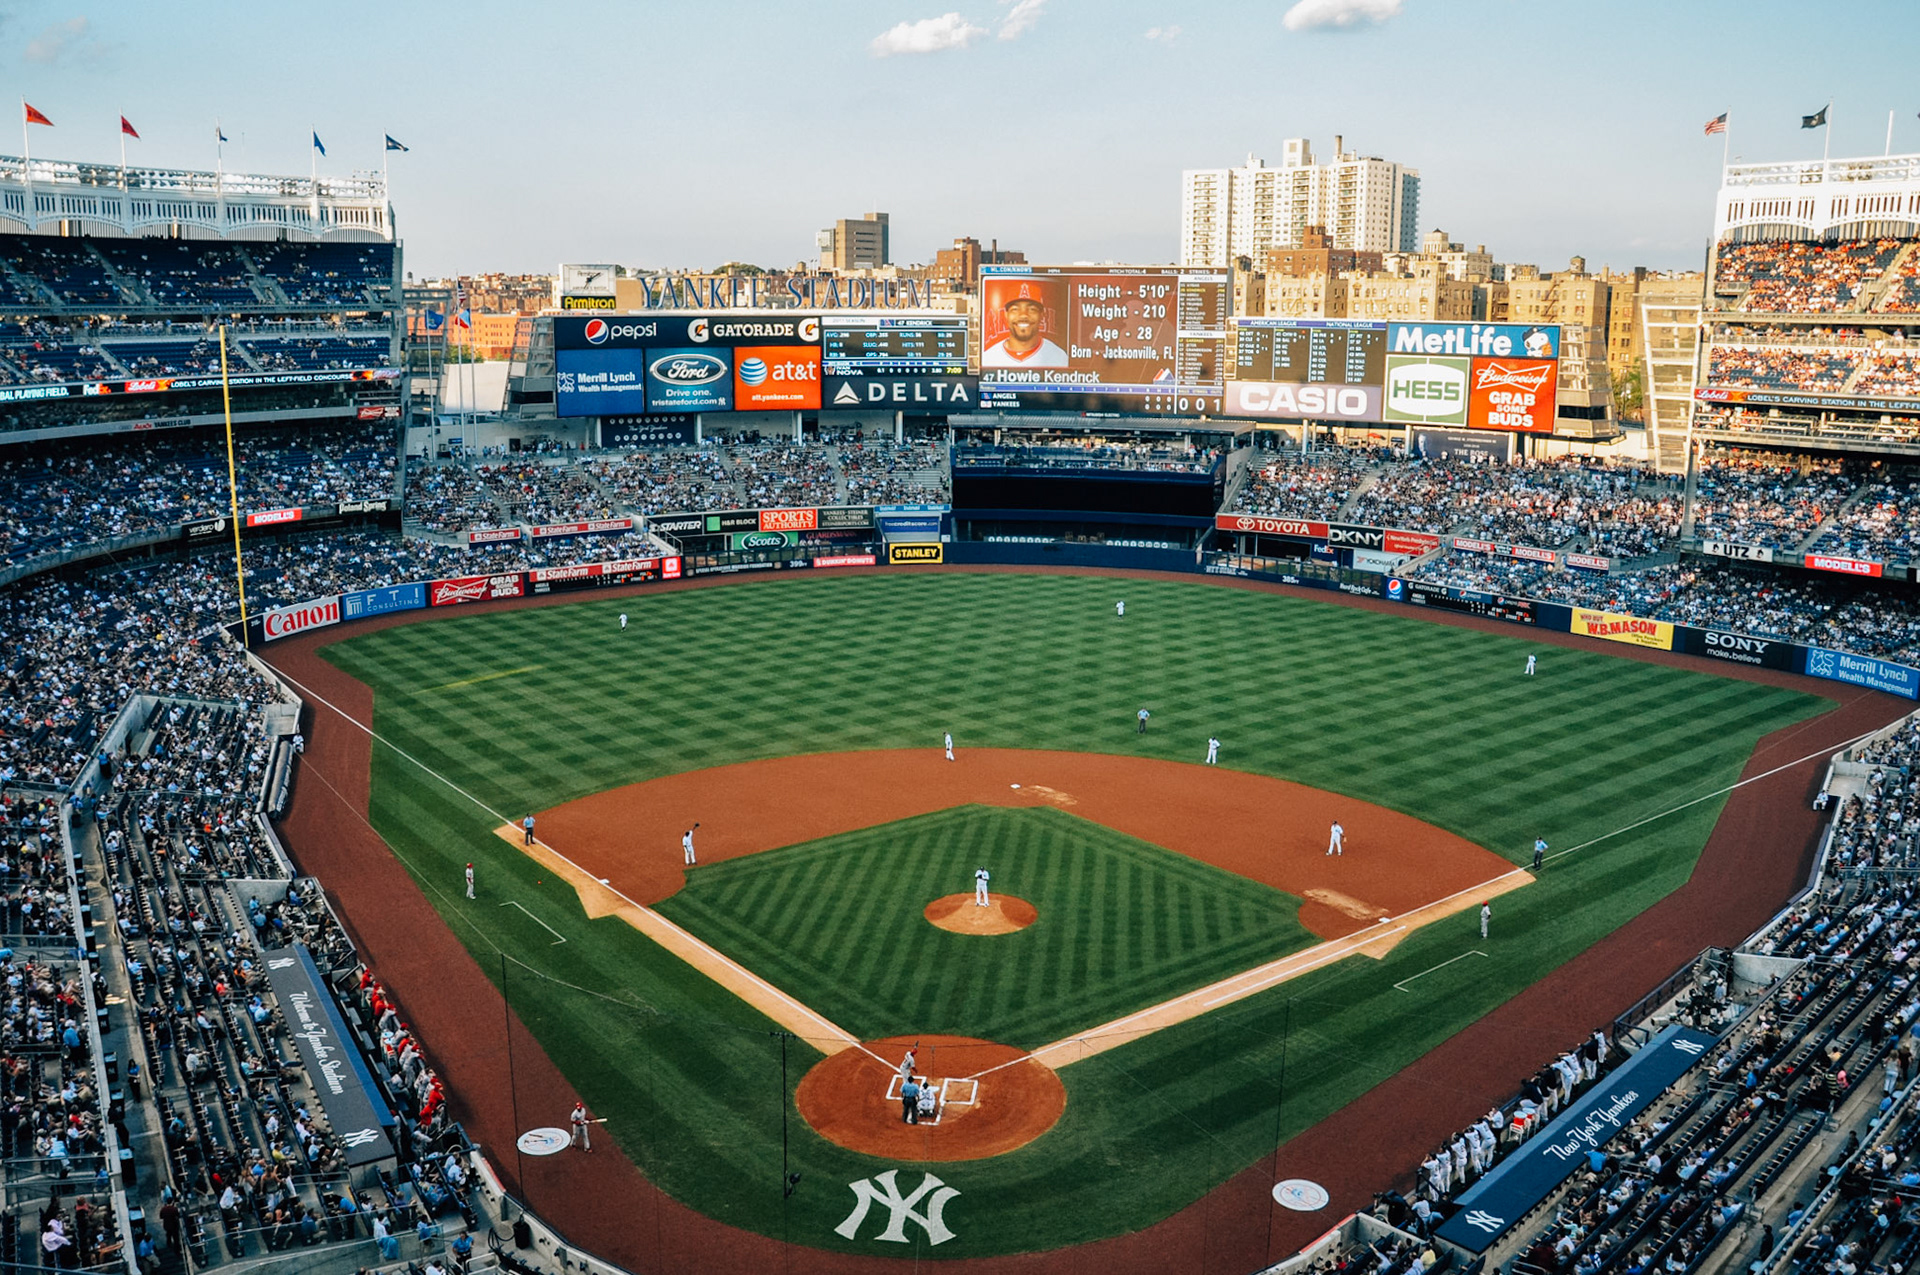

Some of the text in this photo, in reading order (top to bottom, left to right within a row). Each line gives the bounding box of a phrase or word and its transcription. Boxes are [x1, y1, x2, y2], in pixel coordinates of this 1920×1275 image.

[786, 277, 932, 308] STADIUM
[1078, 284, 1121, 301] Height
[564, 296, 615, 309] Armitron
[1082, 303, 1166, 320] Weight 210
[611, 322, 657, 340] pepsi
[713, 323, 794, 337] GATORADE
[1094, 325, 1152, 342] Age 28
[1394, 324, 1512, 356] MetLife
[1071, 344, 1092, 358] Born
[1163, 346, 1174, 359] FL
[668, 359, 709, 378] Ford
[772, 360, 817, 381] at&t
[983, 369, 1100, 383] 47 Howie Kendrick
[1476, 366, 1548, 384] Budweiser
[170, 380, 197, 388] LOBEL'S
[228, 377, 254, 385] STATION
[313, 373, 353, 381] CONCOURSE
[577, 372, 636, 384] Merrill Lynch
[14, 388, 45, 400] PLAYING
[578, 383, 642, 392] Wealth Management
[666, 389, 690, 397] Drive
[868, 382, 969, 402] DELTA
[1393, 379, 1460, 401] HESS
[652, 398, 718, 407] tristateford.com
[1179, 397, 1220, 412] 0 0 1
[1240, 385, 1367, 415] CASIO
[1488, 391, 1536, 406] GRAB
[1696, 390, 1728, 400] Lobel's
[1747, 394, 1780, 402] LOBEL'S
[1782, 396, 1818, 405] CARVING
[1821, 398, 1855, 407] STATION
[1868, 400, 1886, 408] THE
[1496, 405, 1527, 414] SOME
[154, 420, 177, 428] YANKEES
[178, 419, 191, 427] CLUB
[1488, 412, 1533, 427] BUDS
[762, 510, 814, 523] SPORTS
[660, 521, 702, 532] STARTER
[1257, 519, 1310, 535] TOYOTA
[748, 536, 781, 547] Scotts
[1330, 528, 1383, 546] DKNY
[895, 549, 938, 558] STANLEY
[1313, 544, 1334, 554] FedEx
[1457, 540, 1491, 551] MODELL'S
[1515, 548, 1552, 560] MODELL'S
[1723, 544, 1750, 558] UTZ
[1568, 555, 1608, 569] MODELL'S
[1814, 557, 1870, 574] MODELL'S
[490, 575, 520, 585] GRAB
[434, 585, 488, 599] Budweiser
[490, 587, 520, 598] BUDS
[367, 598, 419, 612] CONSULTING
[265, 602, 338, 636] Canon
[1580, 613, 1592, 621] WHO
[1704, 632, 1769, 653] SONY
[1839, 655, 1908, 683] Merrill Lynch
[1838, 669, 1913, 697] Wealth Management
[296, 1027, 336, 1059] Yankee
[318, 1056, 347, 1096] Stadium
[1542, 1090, 1639, 1161] New York Yankees
